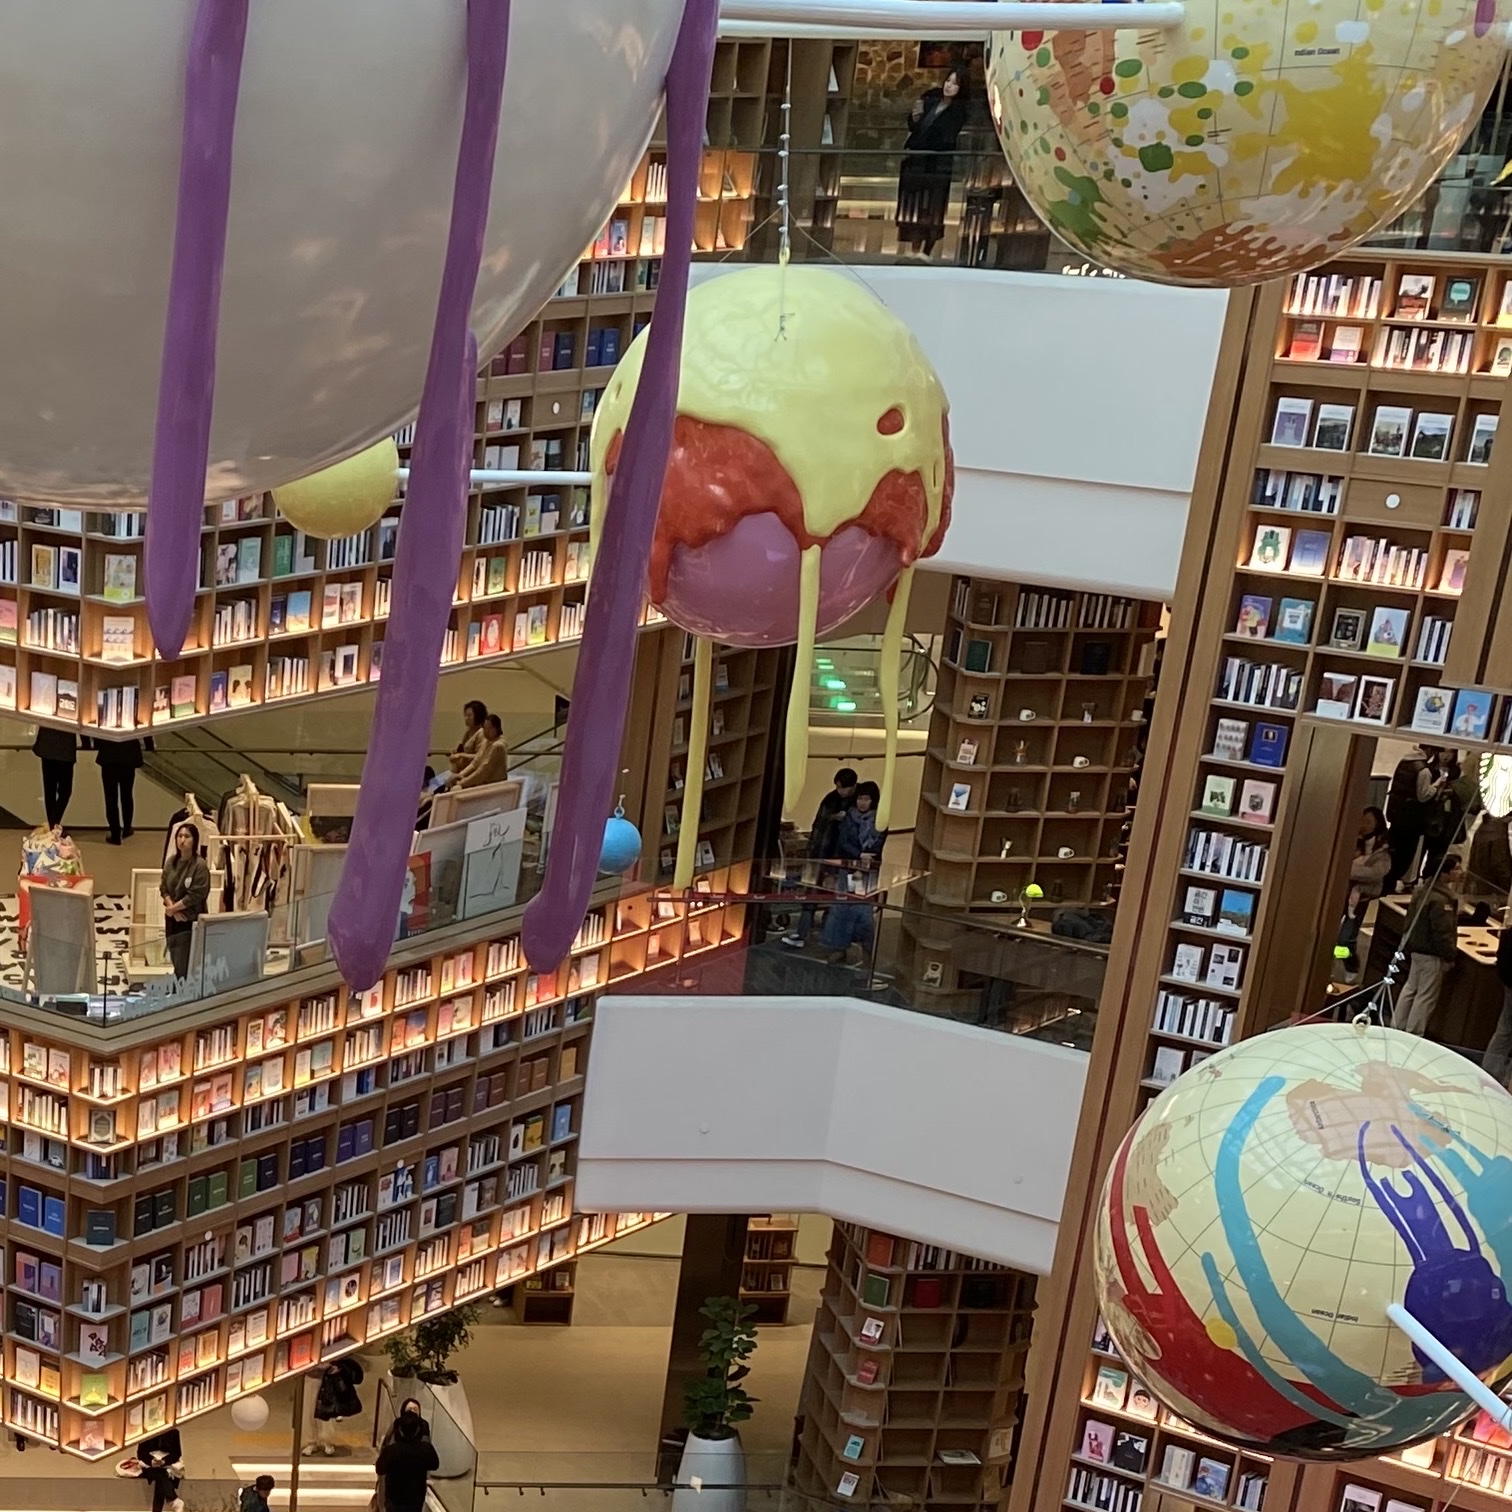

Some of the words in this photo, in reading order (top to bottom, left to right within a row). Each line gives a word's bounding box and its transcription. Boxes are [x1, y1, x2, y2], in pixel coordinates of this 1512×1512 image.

[1327, 1190, 1361, 1206] Southern
[1311, 1308, 1334, 1319] Ocean
[1335, 1313, 1359, 1324] Indian
